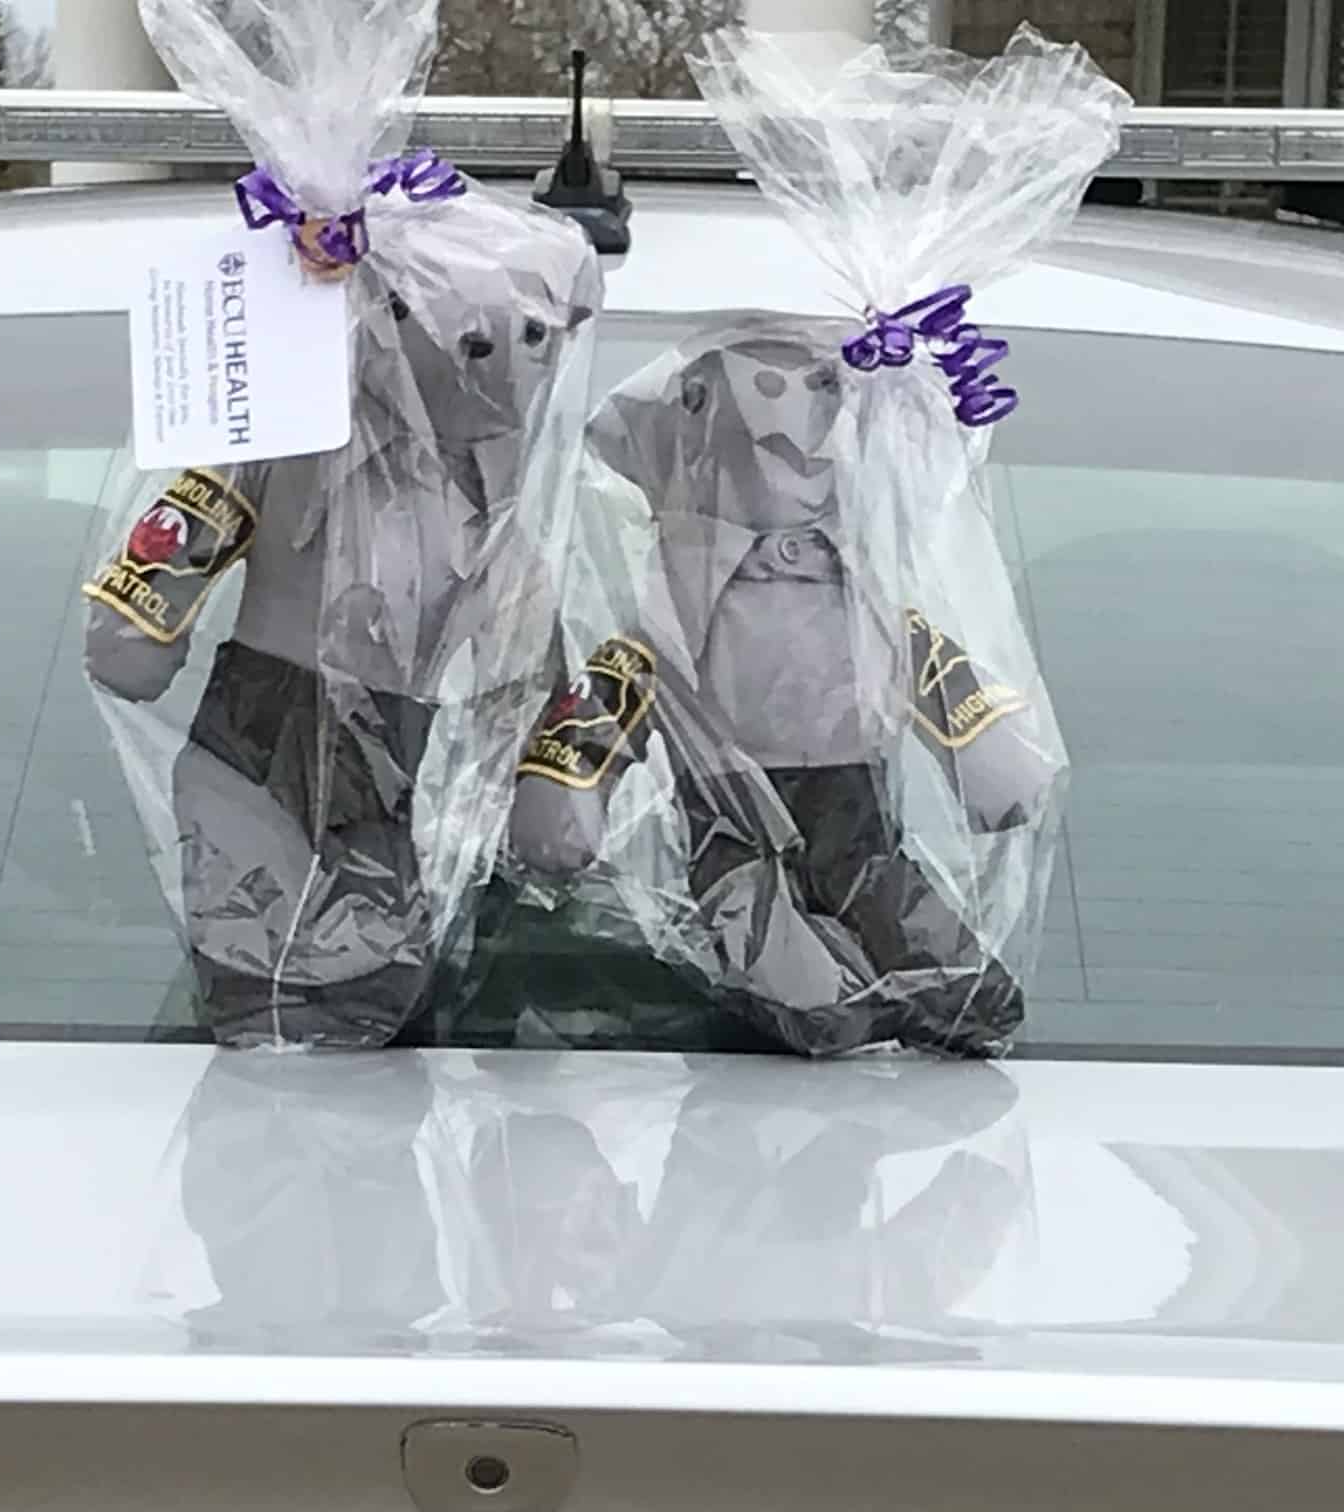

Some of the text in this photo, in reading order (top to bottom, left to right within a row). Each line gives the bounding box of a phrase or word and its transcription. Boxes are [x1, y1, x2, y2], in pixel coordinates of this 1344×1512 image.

[221, 279, 251, 445] ECU HEALTH
[102, 565, 172, 626] PATROL
